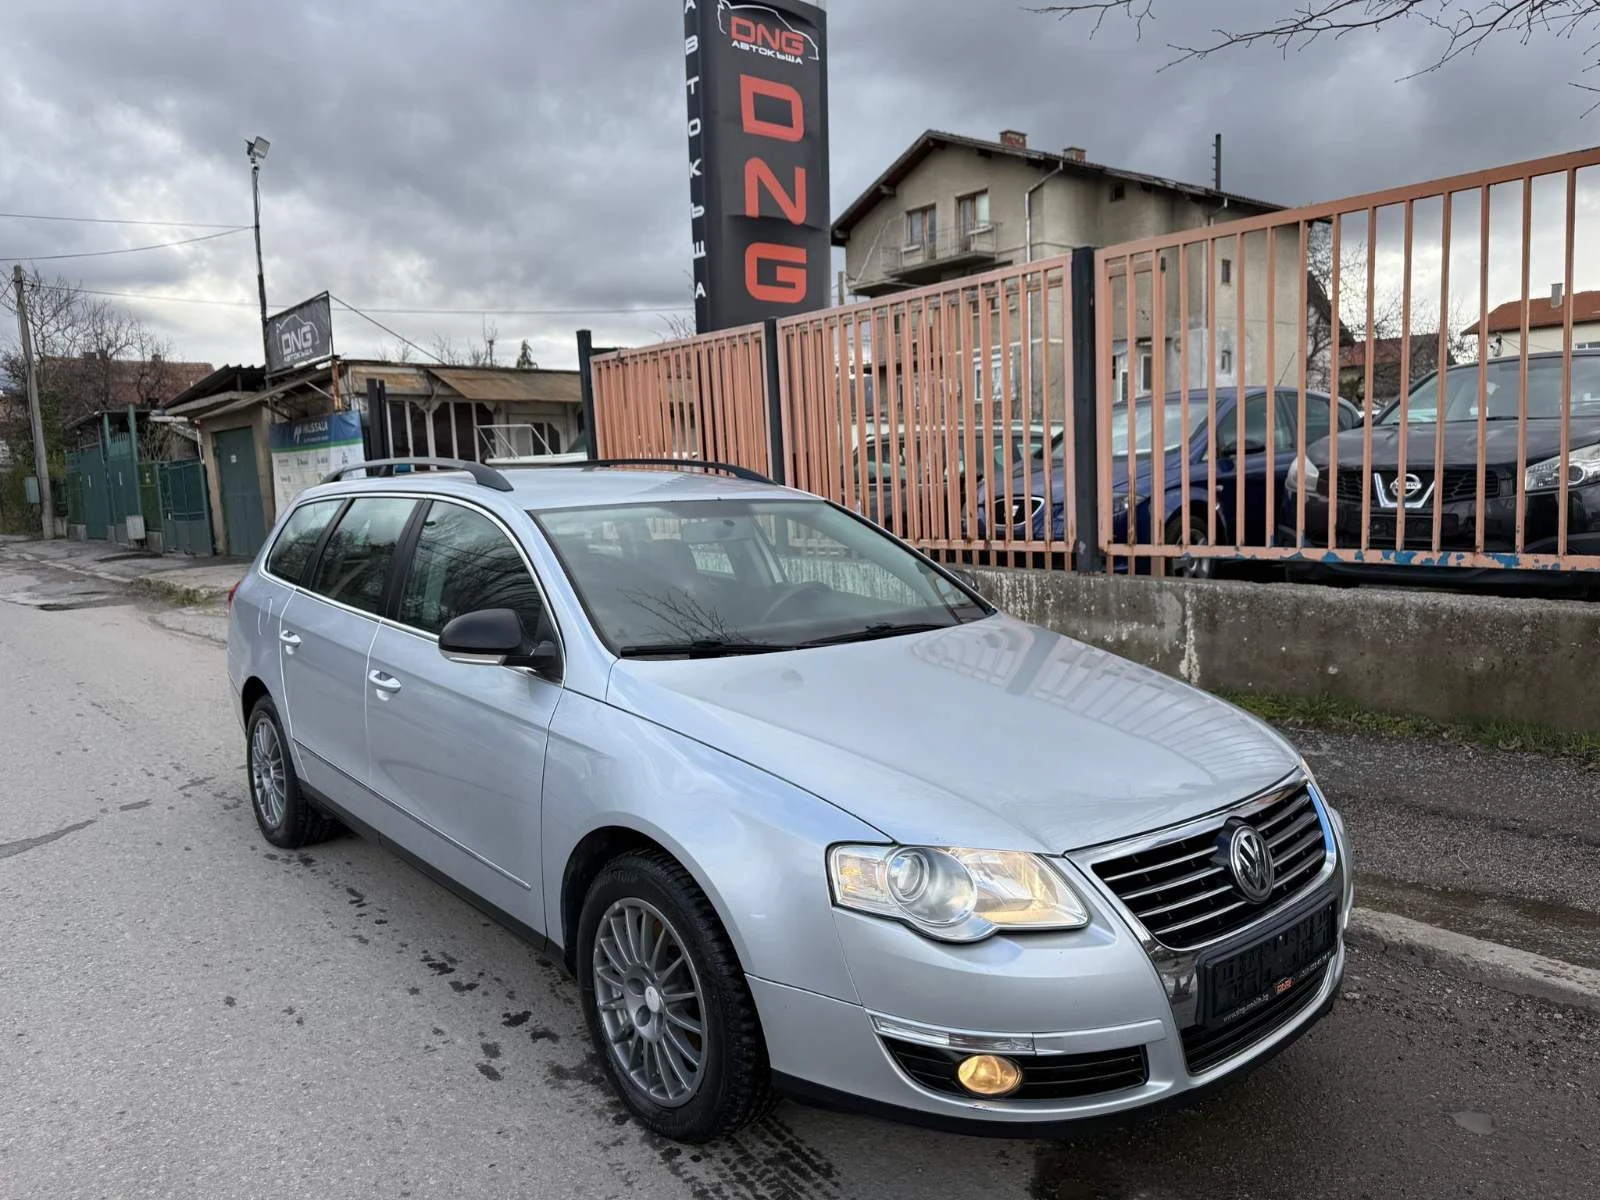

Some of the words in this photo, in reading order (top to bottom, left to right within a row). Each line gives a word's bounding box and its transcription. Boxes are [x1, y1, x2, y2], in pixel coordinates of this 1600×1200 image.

[730, 15, 805, 57] DNG
[731, 40, 804, 65] АВТОКЪША
[739, 73, 807, 304] DNG
[281, 325, 313, 356] DNG
